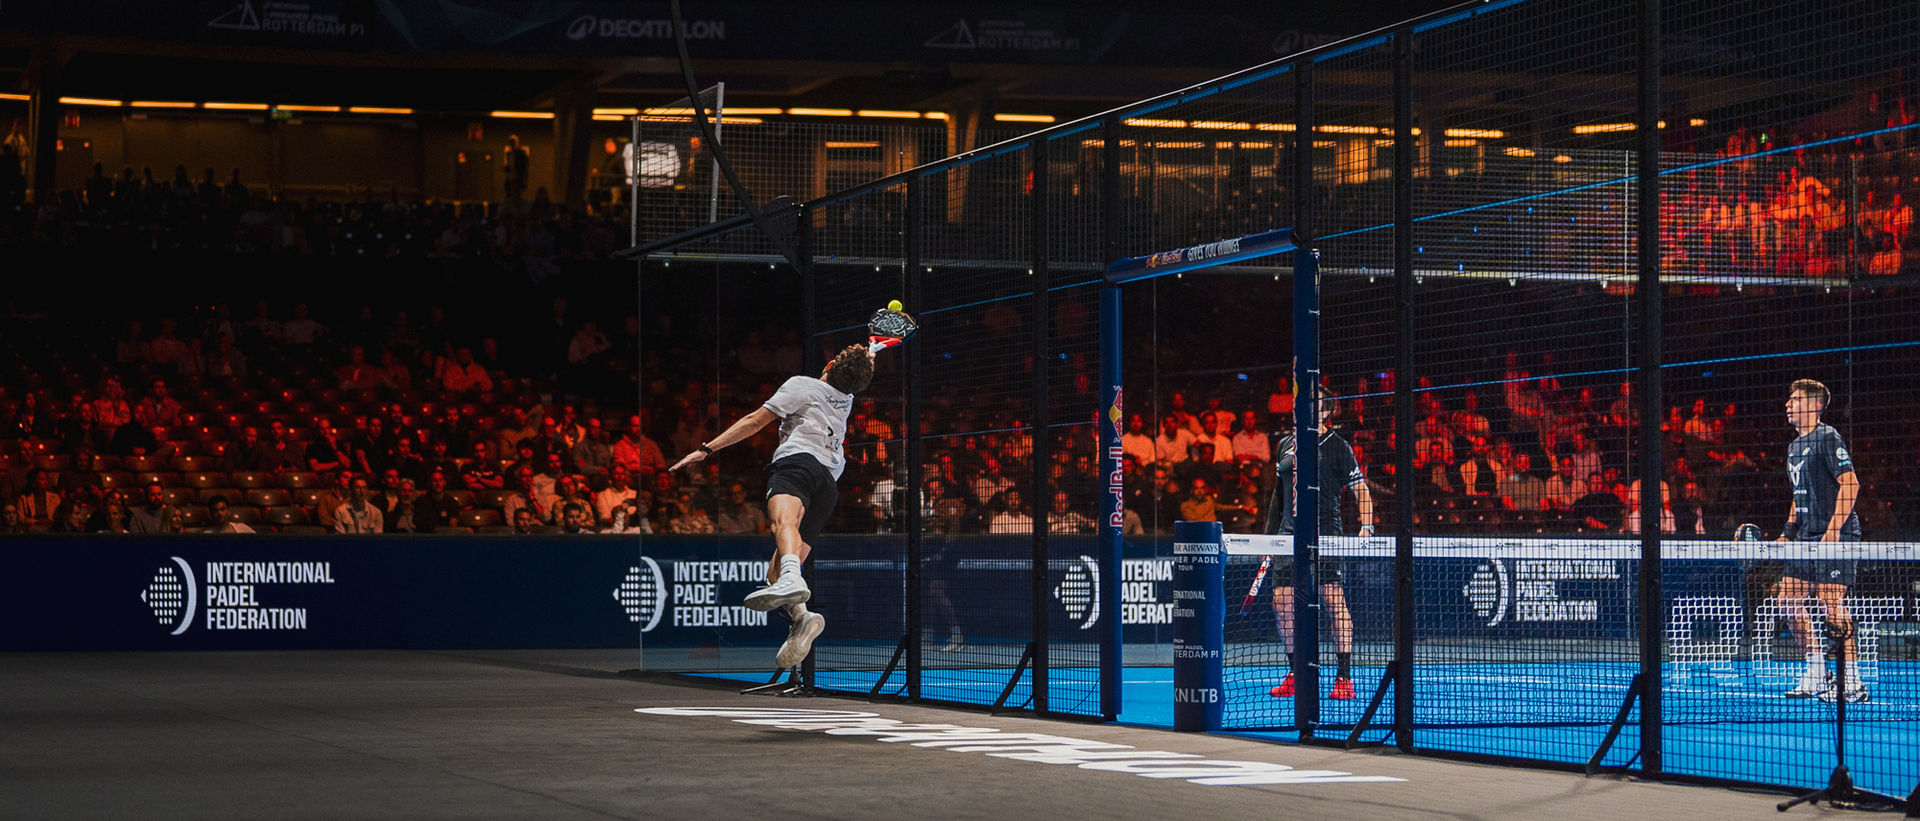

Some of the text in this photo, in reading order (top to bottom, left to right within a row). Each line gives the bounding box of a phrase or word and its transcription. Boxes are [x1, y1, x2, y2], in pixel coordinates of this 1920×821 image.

[262, 18, 365, 37] ROTTERDAM P1
[1205, 242, 1218, 258] YOU
[1183, 544, 1219, 552] AIRWAYS
[1192, 556, 1219, 564] PADEL
[1515, 560, 1620, 580] INTERNATIONAL
[207, 562, 335, 583] INTERNATIONAL
[207, 585, 259, 606] PADEL
[673, 584, 716, 605] PADE
[1121, 581, 1157, 603] ADEL
[1515, 581, 1559, 600] PADEL
[207, 608, 307, 629] FEDERATION
[1121, 603, 1174, 624] EDERAT
[1515, 600, 1598, 621] FEDERATION
[1210, 650, 1219, 659] P1
[732, 718, 1410, 786] DECATHLON
